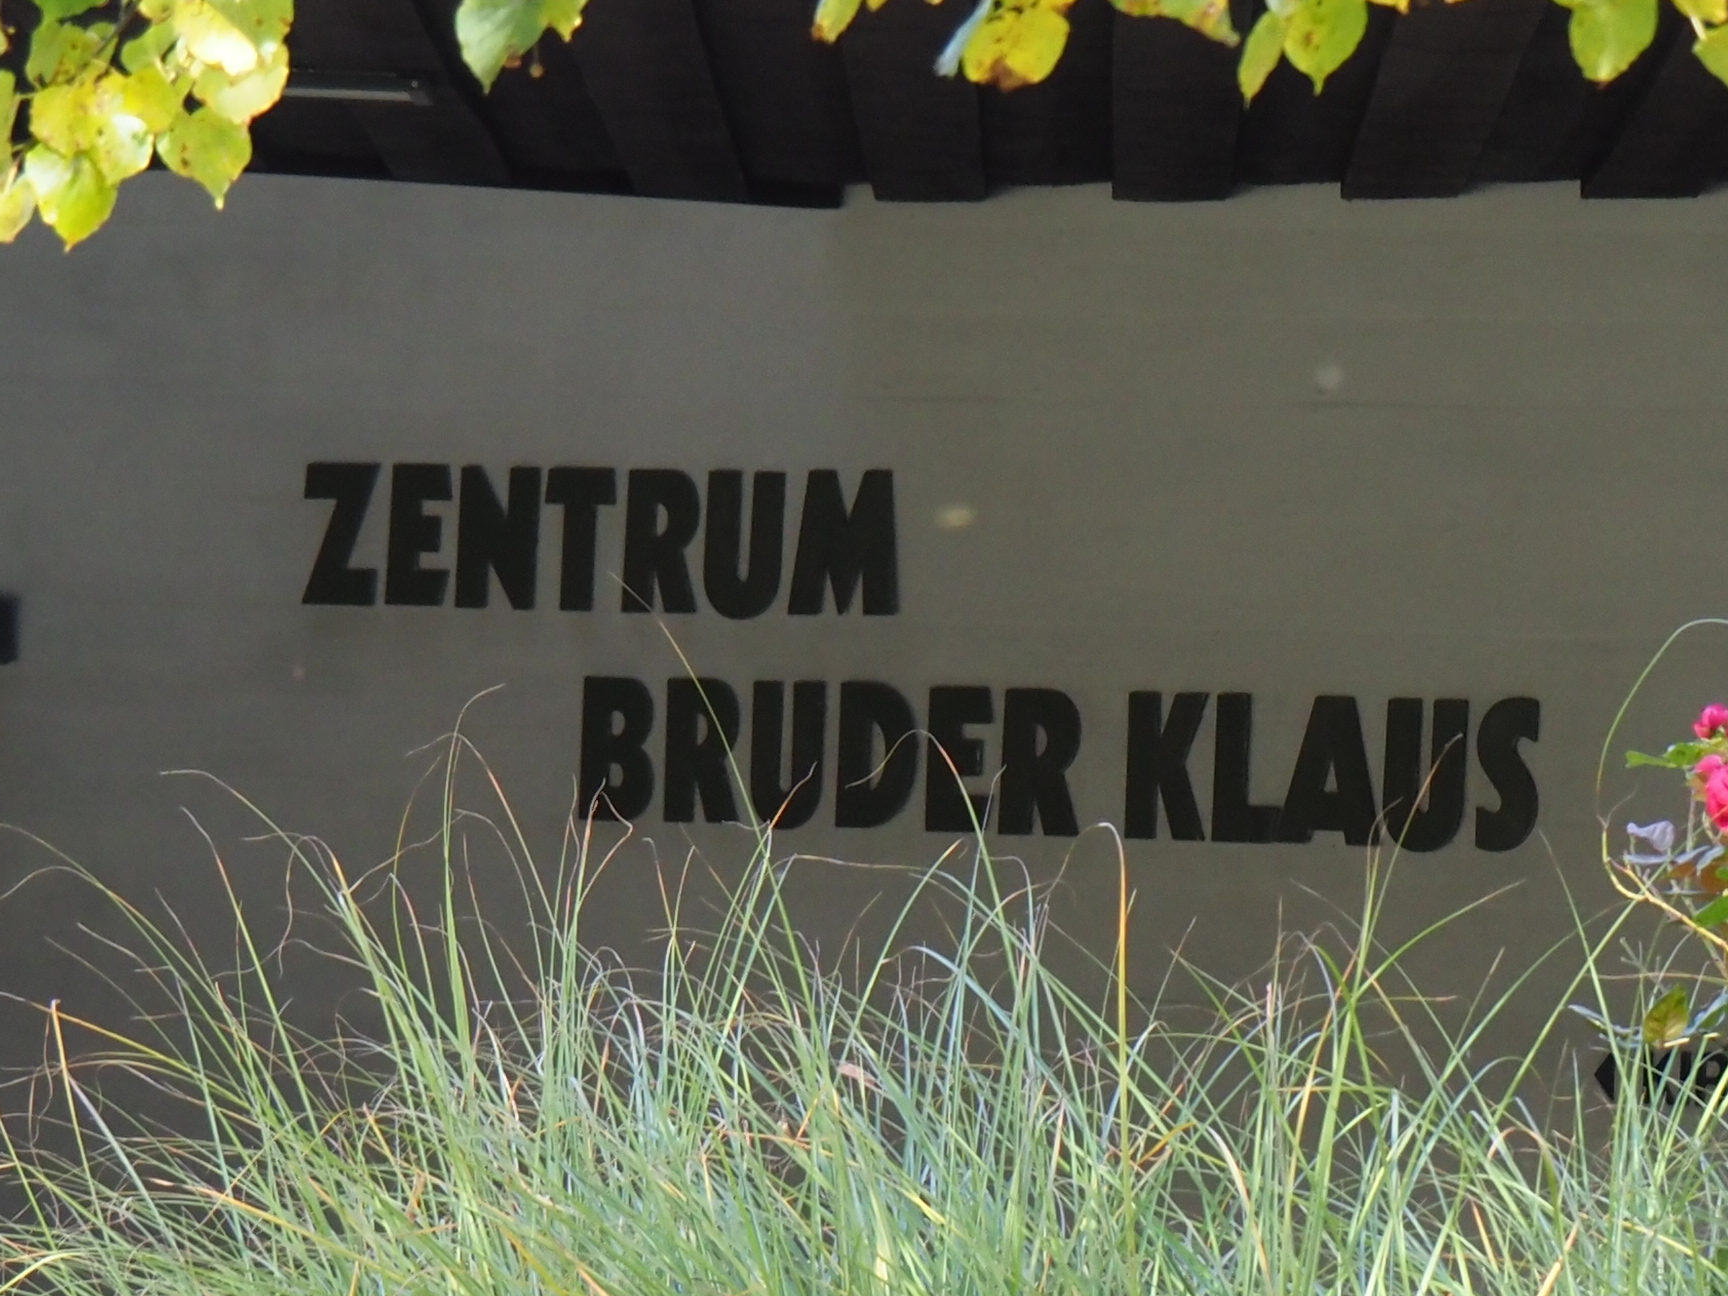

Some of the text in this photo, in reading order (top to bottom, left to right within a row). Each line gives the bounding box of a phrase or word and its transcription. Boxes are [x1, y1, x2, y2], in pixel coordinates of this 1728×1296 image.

[301, 460, 901, 621] ZENTRUM
[577, 675, 1541, 854] BRUDER KLAUS
